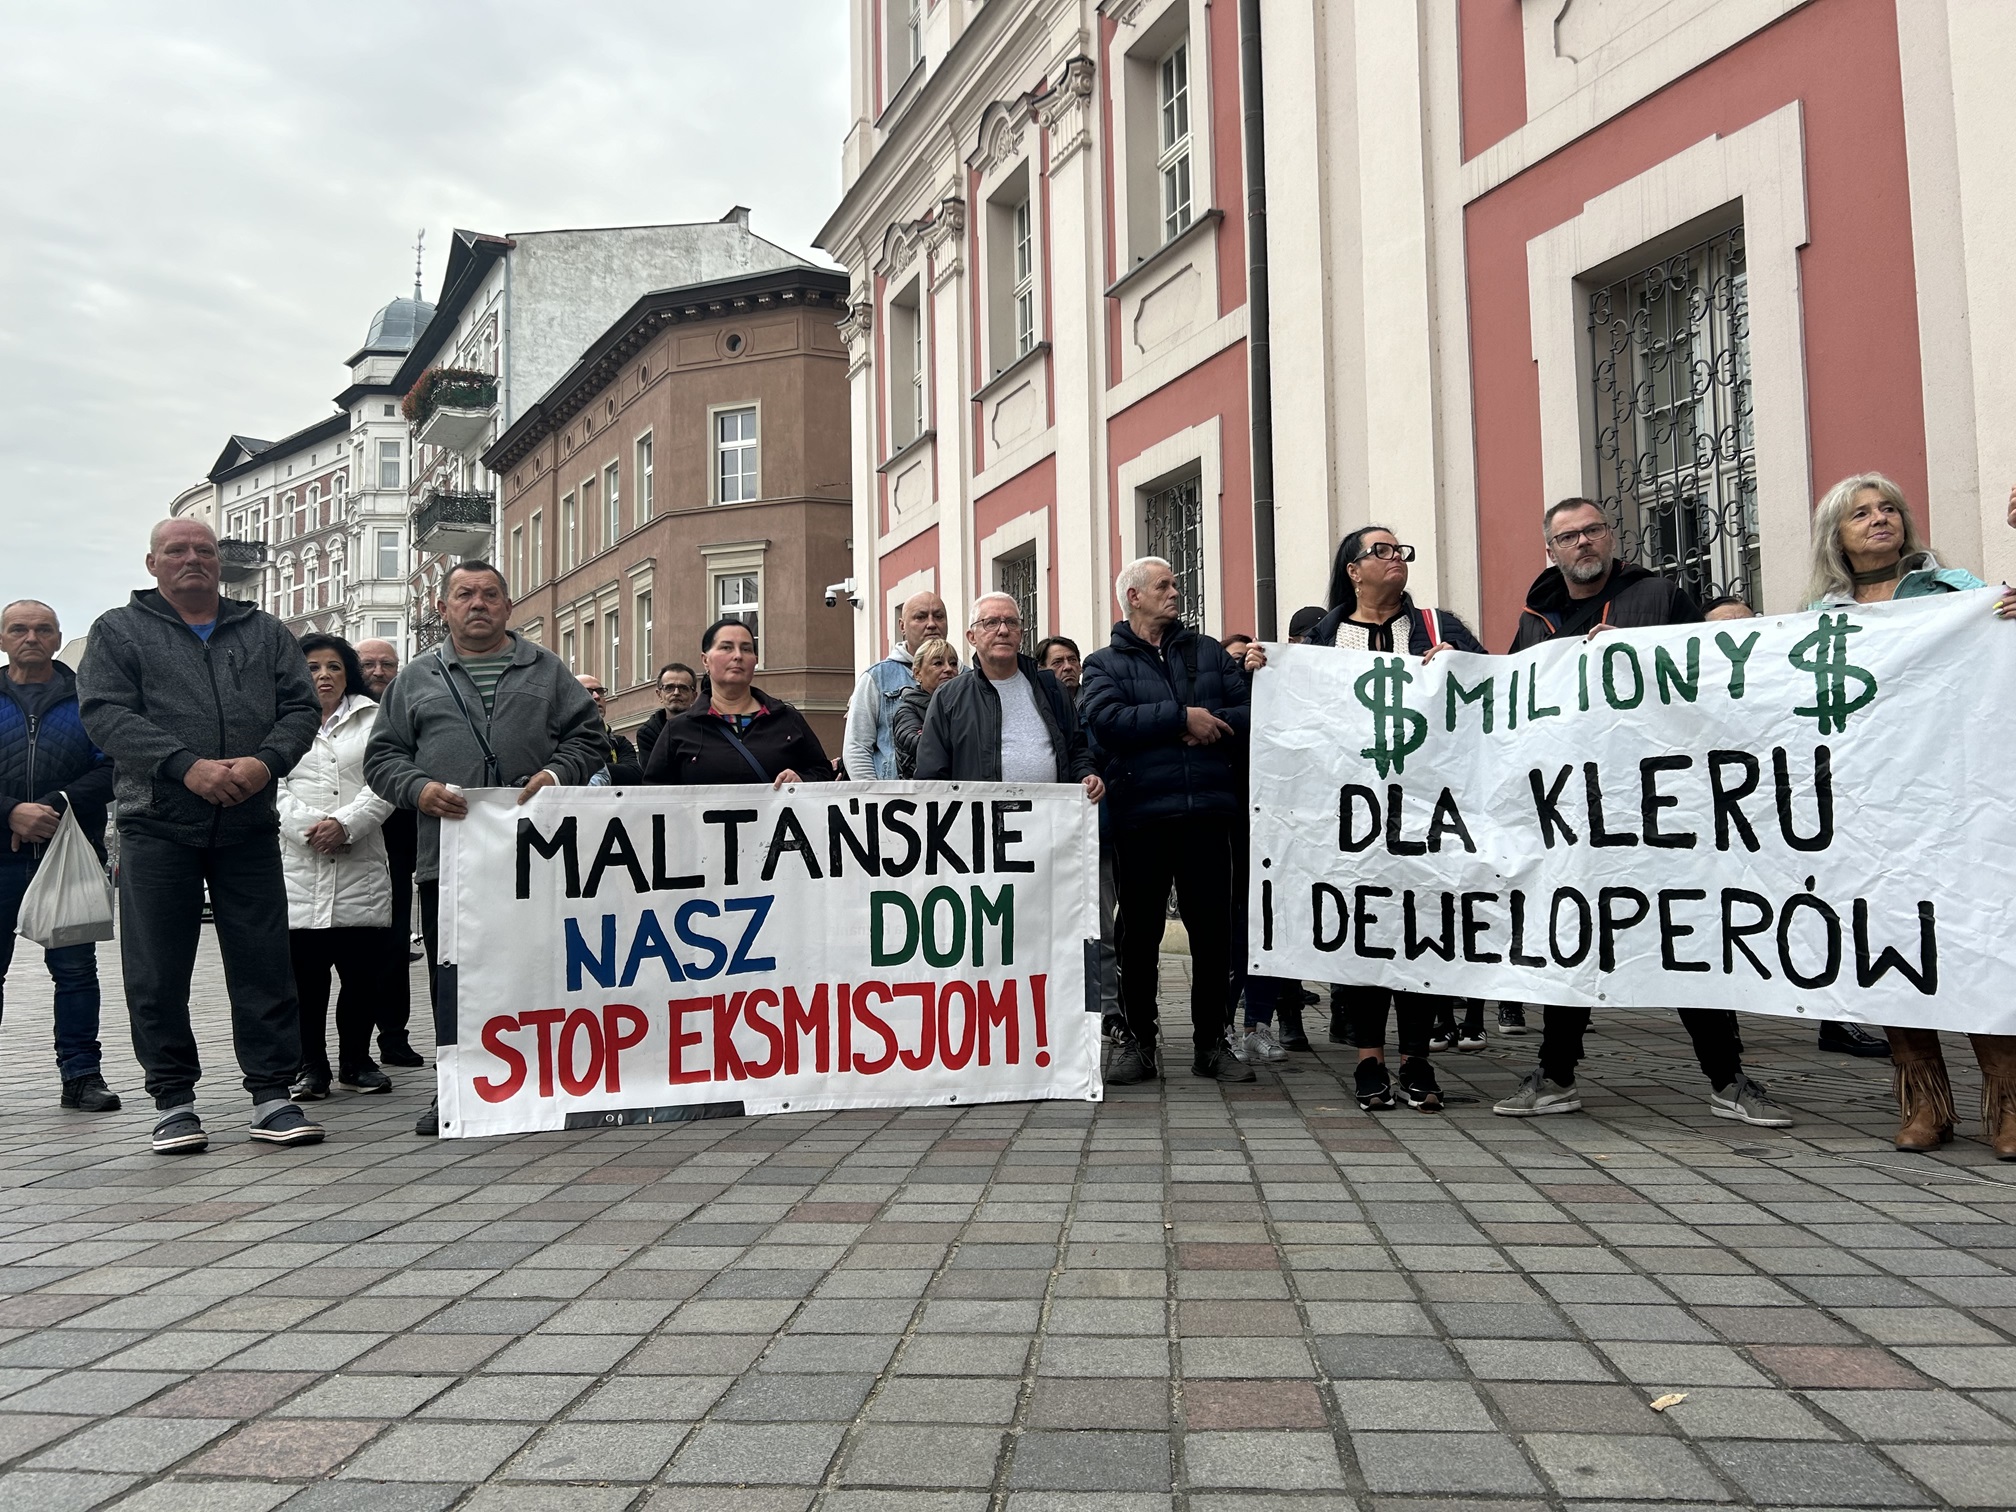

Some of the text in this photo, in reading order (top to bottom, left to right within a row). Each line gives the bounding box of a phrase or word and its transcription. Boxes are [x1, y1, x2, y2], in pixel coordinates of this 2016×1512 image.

[1446, 630, 1761, 734] MILIONY
[515, 798, 1035, 900] MALTAŃSKIE
[1339, 745, 1833, 856] DLA KLERU
[565, 884, 1013, 991] NASZ DOM
[1312, 876, 1938, 996] DEWELOPERÓW
[474, 974, 1050, 1102] STOP EKSMISJOM!
